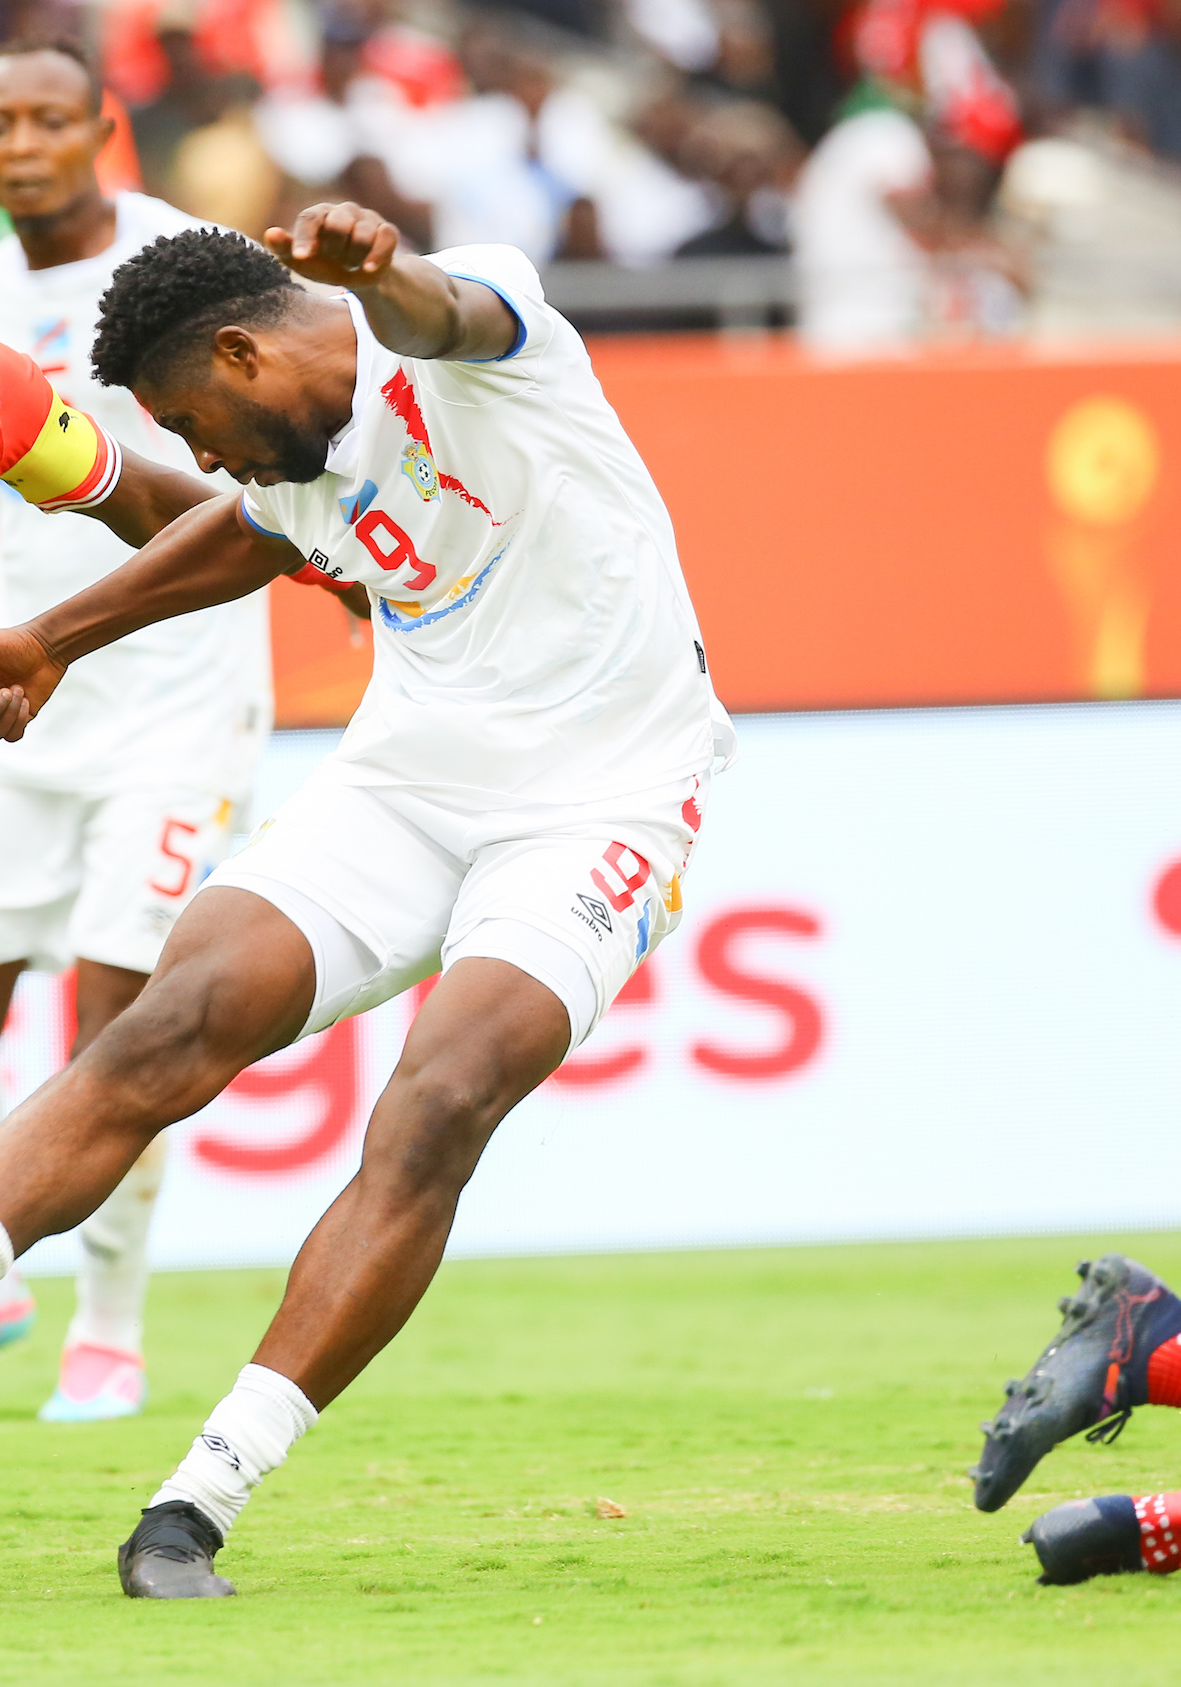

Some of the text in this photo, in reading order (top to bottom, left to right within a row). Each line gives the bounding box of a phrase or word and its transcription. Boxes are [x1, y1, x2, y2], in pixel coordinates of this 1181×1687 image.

[355, 509, 437, 591] 9
[147, 817, 198, 899] 5
[589, 840, 651, 913] 9
[570, 906, 603, 942] umbro
